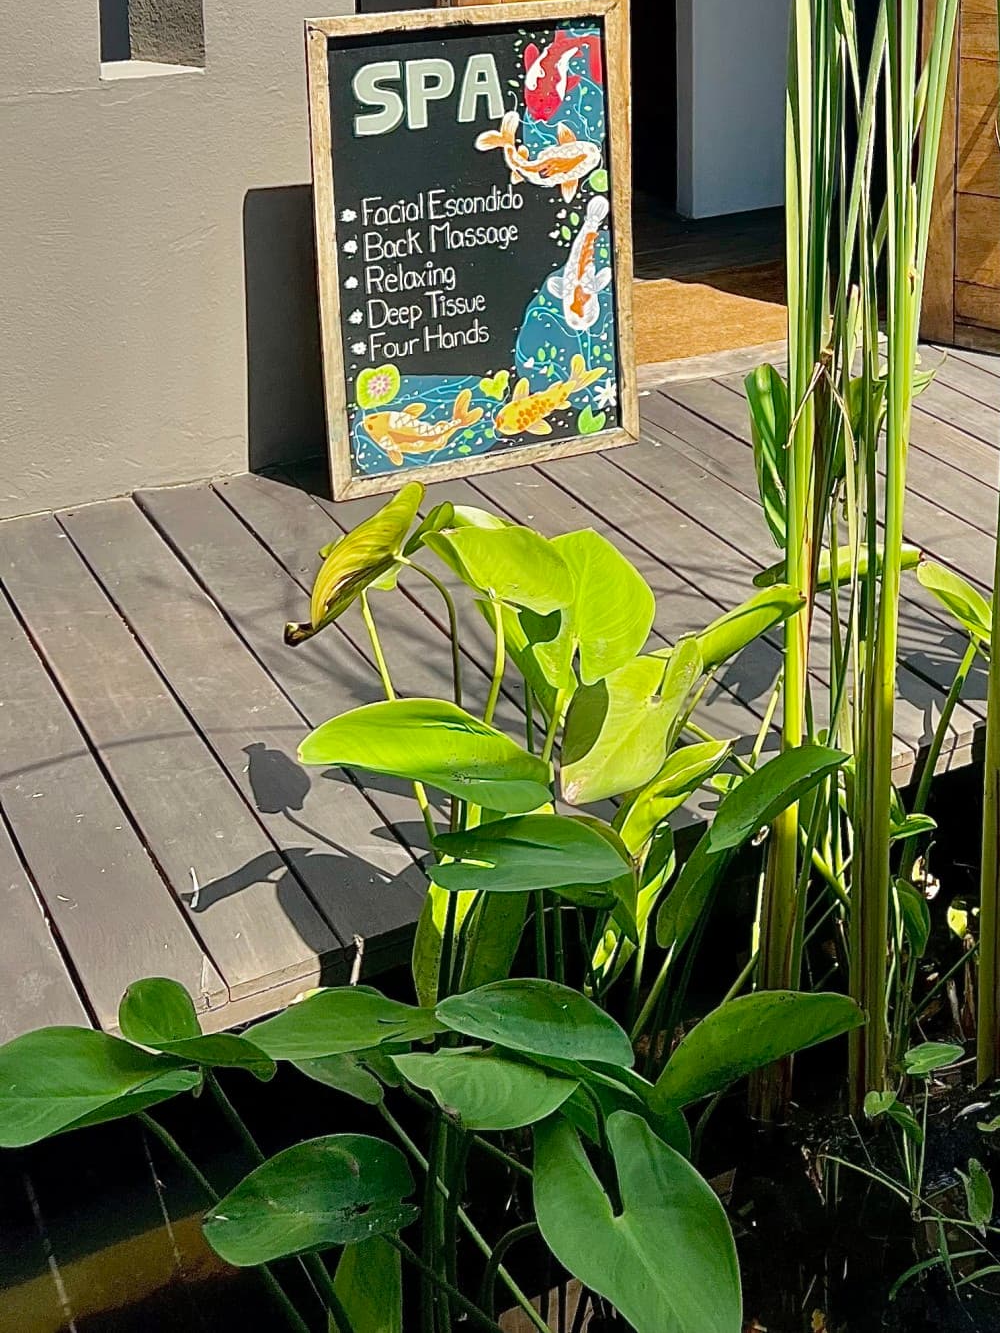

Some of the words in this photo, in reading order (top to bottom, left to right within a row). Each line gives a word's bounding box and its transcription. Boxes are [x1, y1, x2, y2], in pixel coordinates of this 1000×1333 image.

[353, 53, 505, 137] SPA
[361, 192, 424, 226] Facial
[427, 184, 524, 220] Escondido
[364, 228, 423, 262] Back
[429, 222, 518, 253] Massage
[365, 261, 456, 294] Relaxing
[367, 299, 423, 330] Deep
[424, 290, 487, 318] Tissue
[368, 332, 420, 362] Four
[423, 318, 490, 353] Hands
